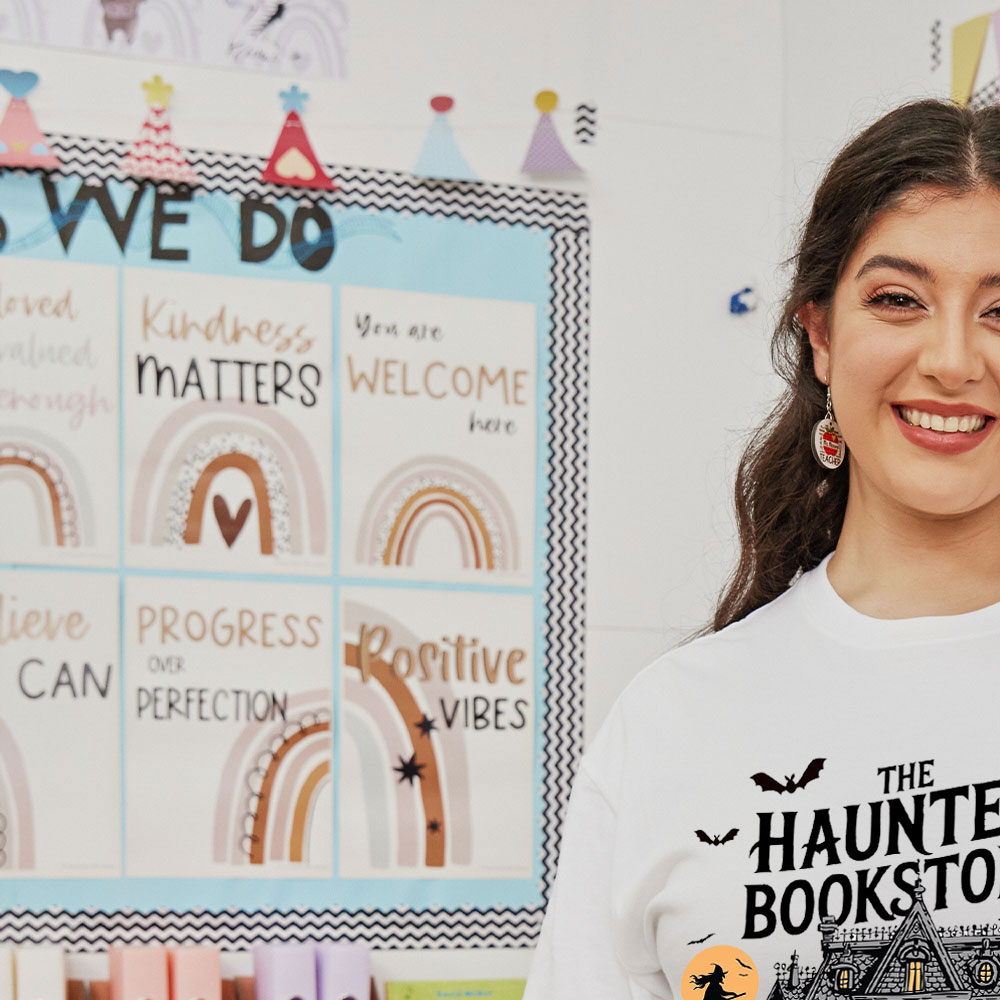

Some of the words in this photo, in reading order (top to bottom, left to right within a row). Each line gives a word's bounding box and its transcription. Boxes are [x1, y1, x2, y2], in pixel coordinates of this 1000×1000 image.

[40, 175, 193, 261] WE
[240, 193, 335, 272] DO
[142, 294, 317, 355] Kindness
[355, 312, 398, 340] You
[409, 322, 443, 342] are
[137, 353, 322, 408] MATTERS
[347, 354, 529, 405] WELCOME
[468, 410, 518, 436] here
[137, 605, 323, 648] PROGRESS
[149, 655, 185, 675] OVER
[358, 622, 527, 685] Positive
[18, 658, 112, 700] CAN
[136, 687, 289, 722] PERFECTION
[440, 696, 529, 731] VIBES
[877, 759, 935, 794] THE
